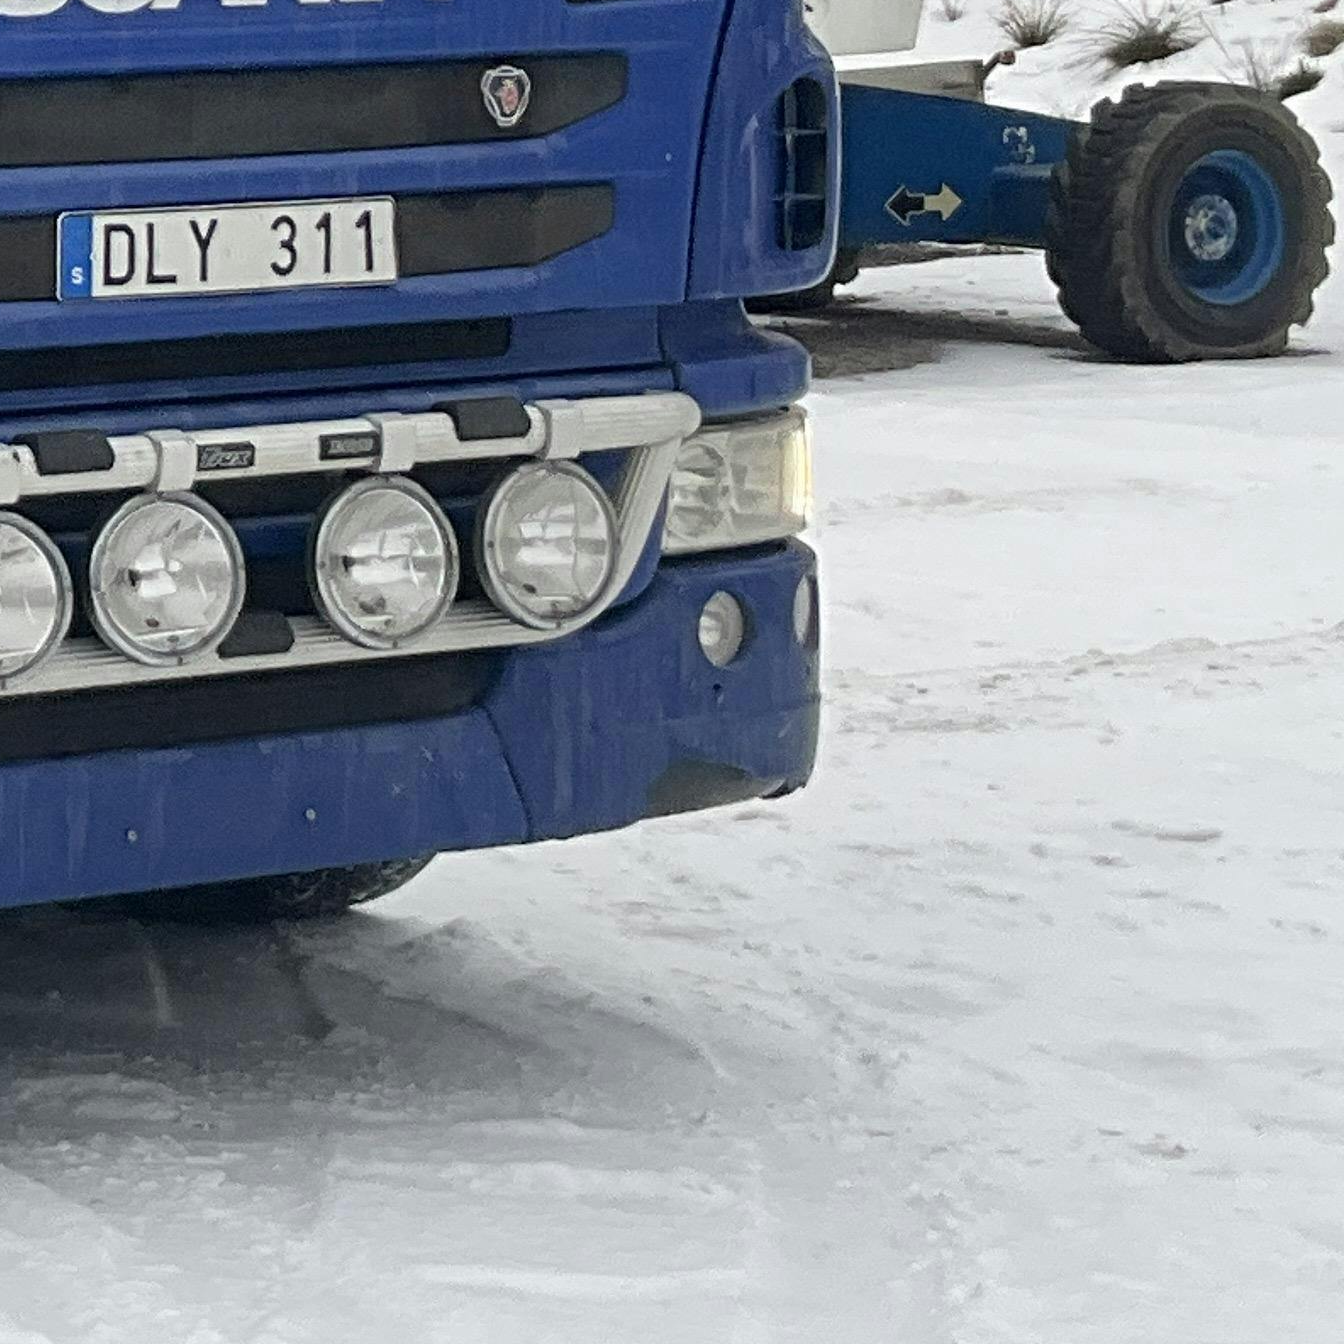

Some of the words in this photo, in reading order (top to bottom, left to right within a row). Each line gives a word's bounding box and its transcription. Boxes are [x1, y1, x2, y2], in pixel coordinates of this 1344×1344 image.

[103, 219, 218, 286] DLY
[270, 209, 374, 277] 311
[71, 266, 86, 286] S
